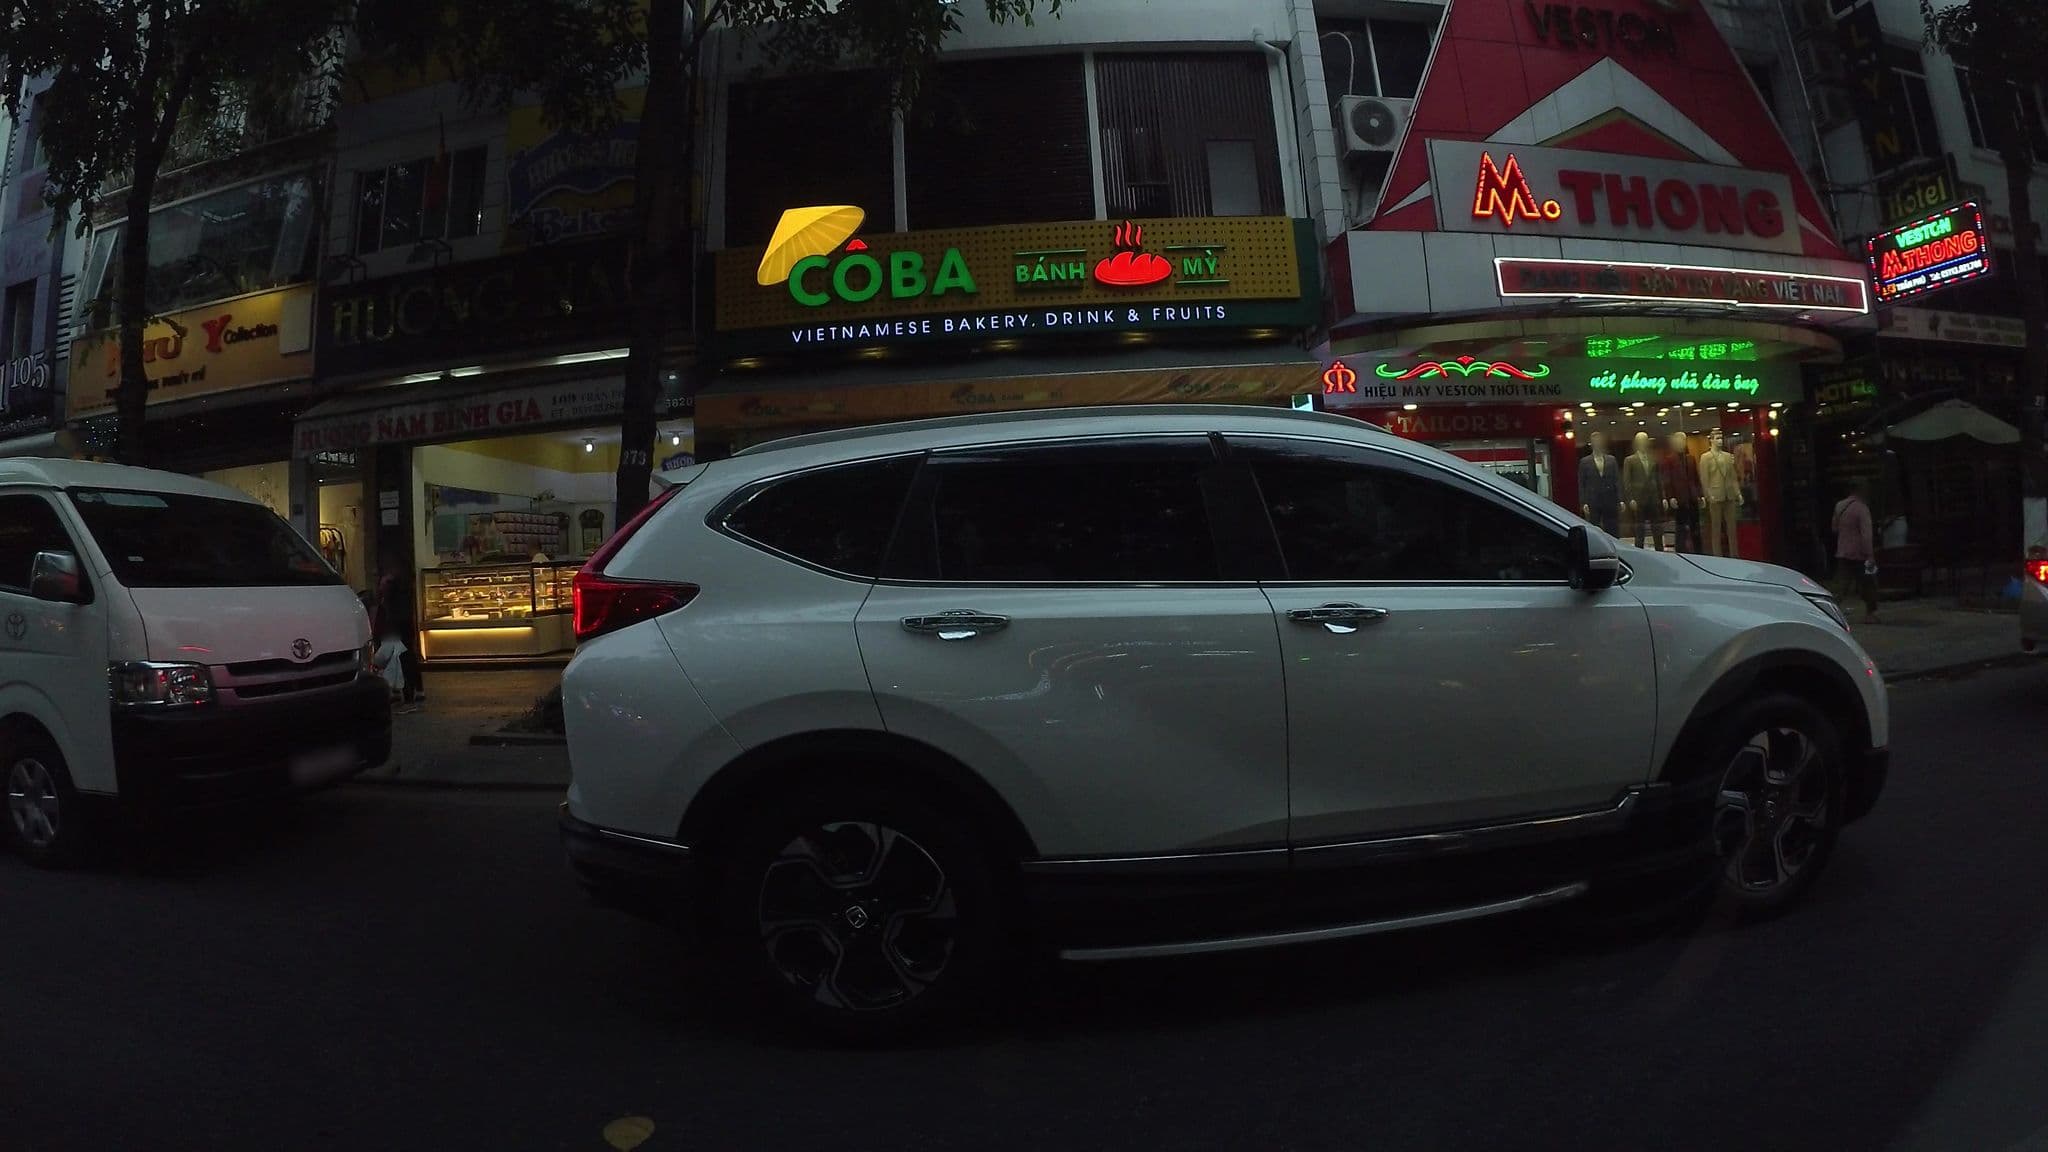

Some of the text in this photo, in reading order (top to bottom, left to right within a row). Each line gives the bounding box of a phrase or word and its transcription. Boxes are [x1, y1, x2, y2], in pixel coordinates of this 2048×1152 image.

[1558, 170, 1786, 238] THONG
[788, 238, 977, 307] CÔBA
[1015, 256, 1086, 283] BÁNH
[791, 320, 931, 344] VIETNAMESE
[1045, 309, 1115, 327] DRINK
[1127, 308, 1140, 322] &
[1153, 305, 1227, 321] FRUITS
[1365, 383, 1396, 400] HIỆU
[1402, 385, 1431, 397] MAY
[1436, 385, 1486, 397] VESTON
[1523, 384, 1562, 396] TRANG
[1589, 369, 1617, 389] nét
[1619, 370, 1667, 396] phong
[378, 412, 427, 441] NAM
[498, 396, 543, 424] GIA
[1397, 413, 1511, 434] TAILOR'S
